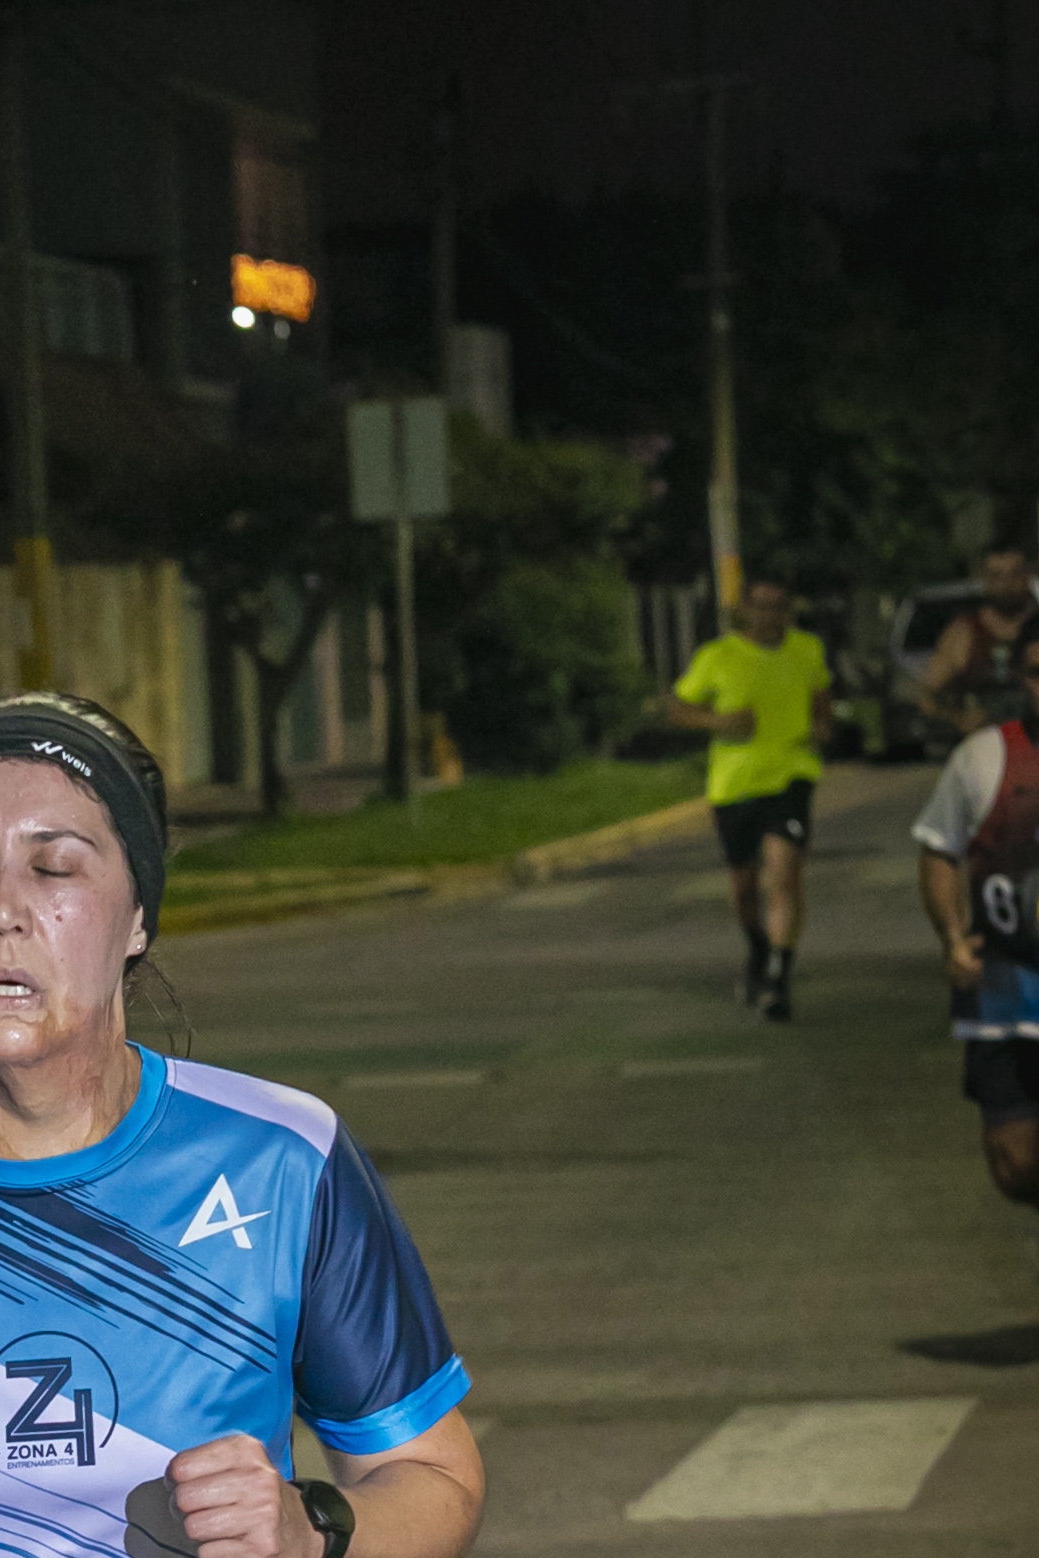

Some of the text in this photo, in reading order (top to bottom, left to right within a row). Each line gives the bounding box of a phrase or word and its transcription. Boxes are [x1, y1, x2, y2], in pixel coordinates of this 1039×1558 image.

[7, 1442, 74, 1460] ZONA 4
[7, 1457, 75, 1470] ENTRENAMIENTOS
